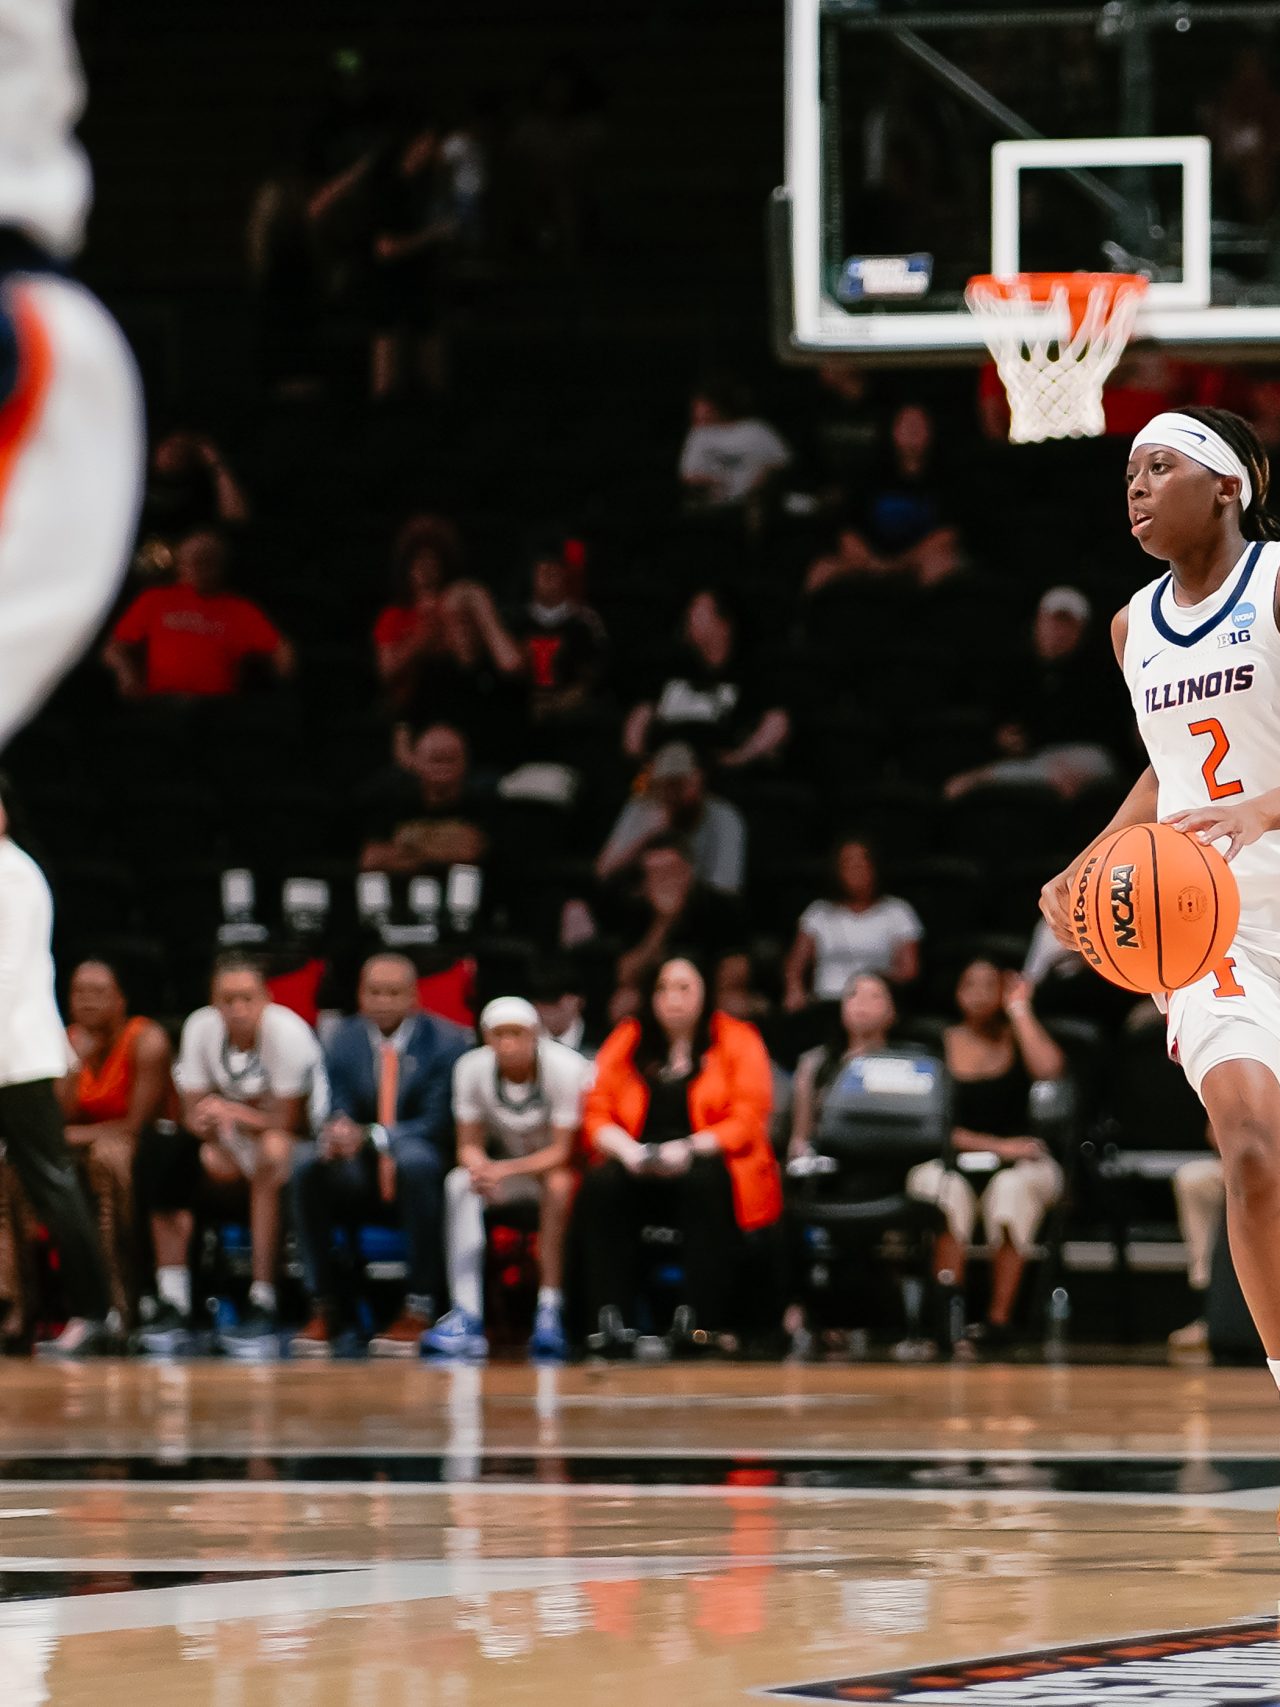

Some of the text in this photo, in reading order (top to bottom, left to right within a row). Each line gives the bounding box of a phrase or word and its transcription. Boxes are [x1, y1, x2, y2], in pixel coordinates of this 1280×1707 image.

[1234, 612, 1254, 622] NCAA
[1145, 664, 1255, 714] ILLINOIS
[1188, 717, 1244, 801] 2
[1112, 864, 1140, 948] NCAA
